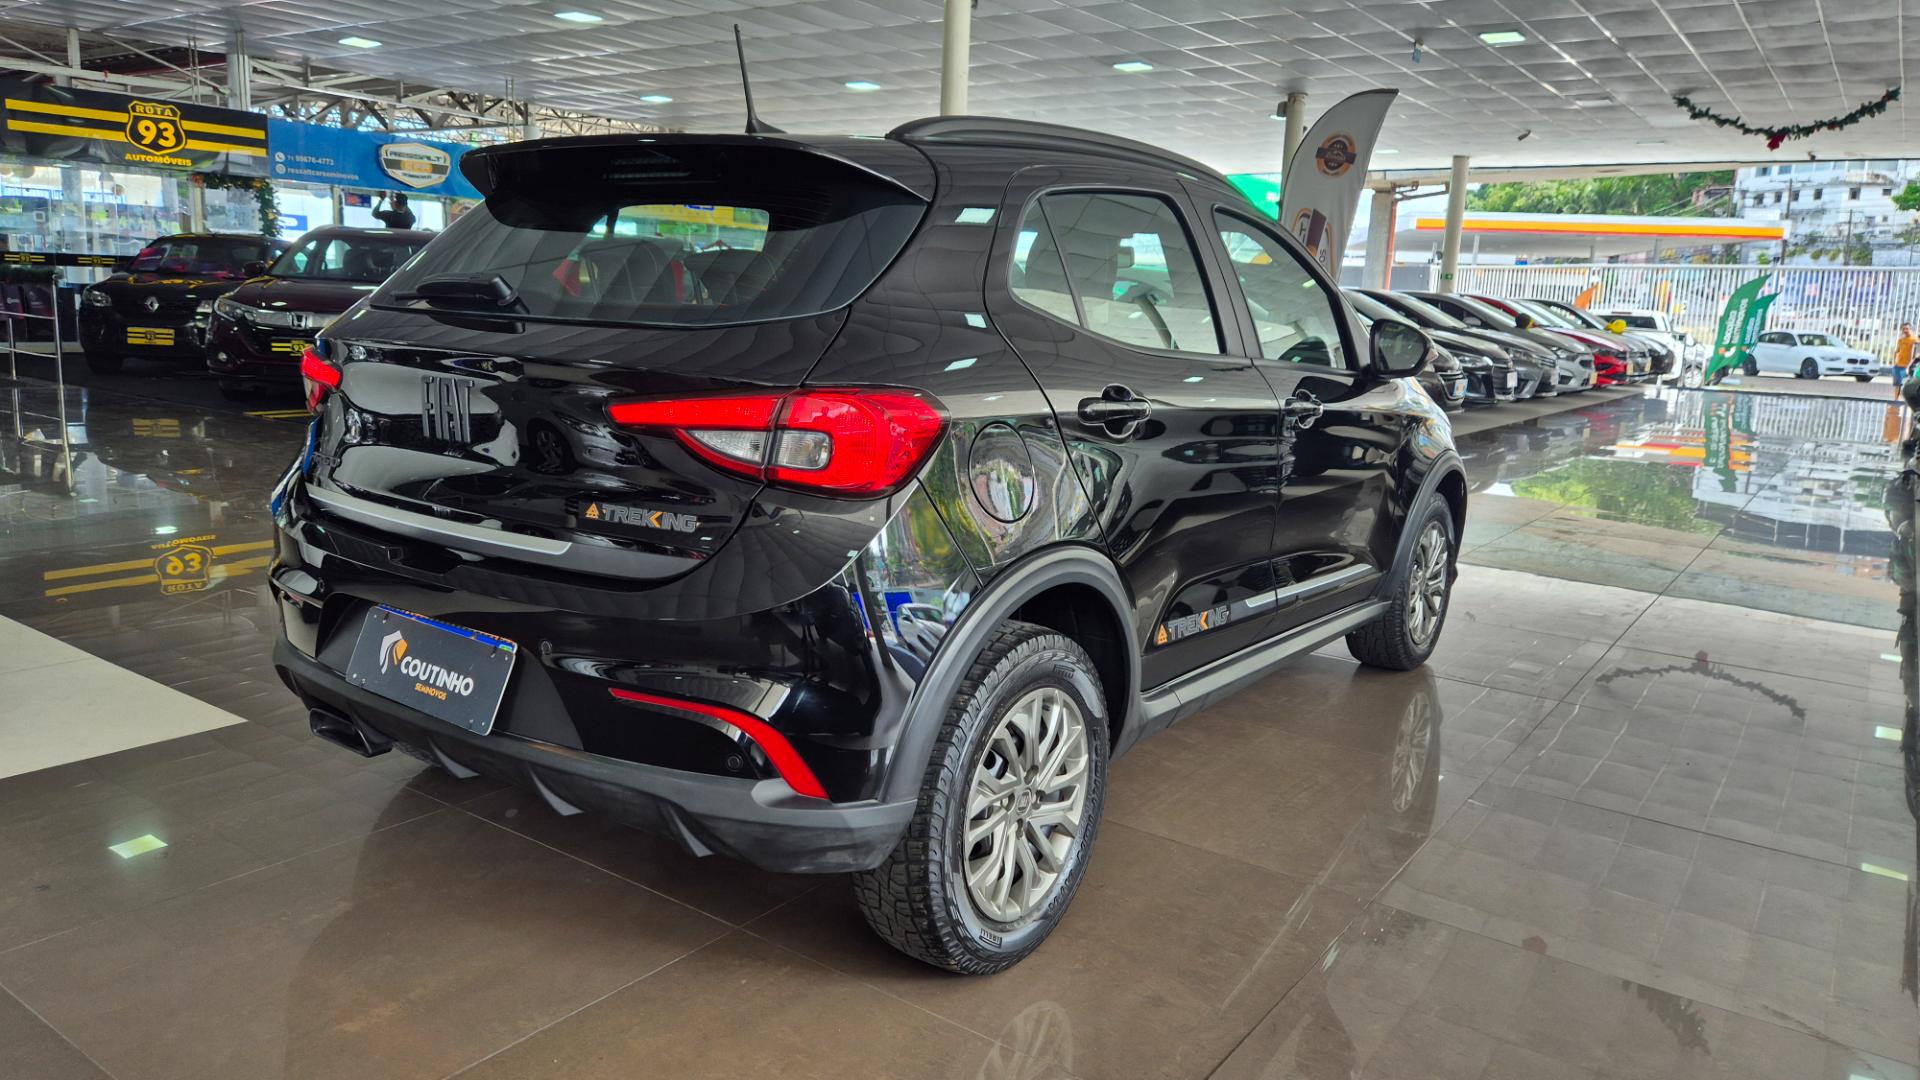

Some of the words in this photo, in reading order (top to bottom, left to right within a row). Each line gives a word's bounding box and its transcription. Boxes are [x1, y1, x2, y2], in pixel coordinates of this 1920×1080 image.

[135, 104, 173, 117] ROTA
[137, 119, 176, 148] 93
[125, 153, 193, 167] AUTOMÓVEIS
[421, 376, 475, 443] FIAT
[400, 655, 475, 697] COUTINHO
[414, 682, 449, 701] SEMINOVOS
